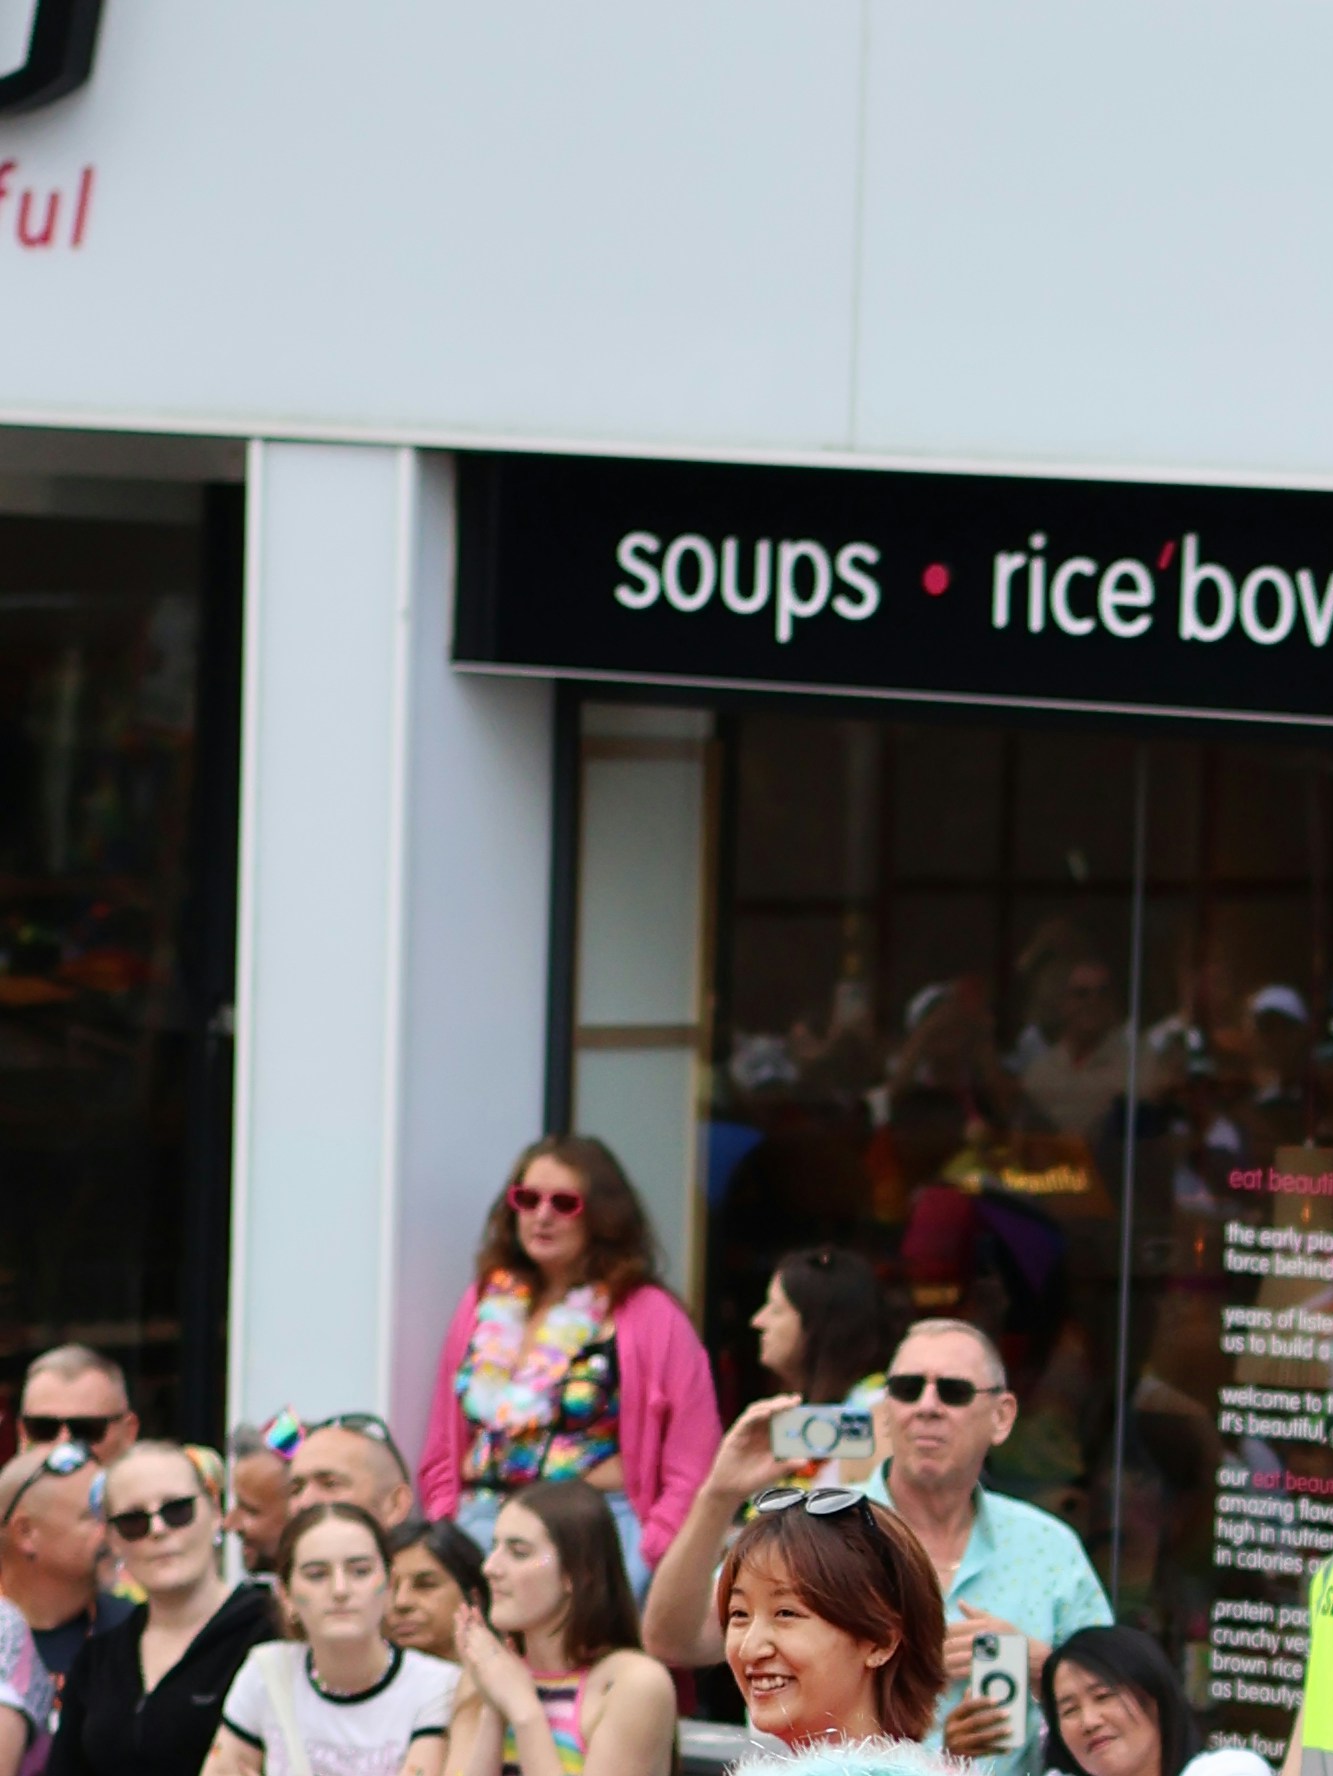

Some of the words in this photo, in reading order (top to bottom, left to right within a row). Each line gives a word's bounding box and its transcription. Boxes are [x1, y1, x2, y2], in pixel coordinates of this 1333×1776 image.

[614, 531, 881, 645] soups
[1227, 1168, 1263, 1190] eat
[1225, 1223, 1254, 1246] the
[1259, 1227, 1302, 1252] early
[1224, 1249, 1270, 1274] force
[1223, 1308, 1272, 1330] years
[1276, 1307, 1296, 1330] of
[1223, 1335, 1245, 1353] us
[1249, 1335, 1267, 1354] to
[1270, 1333, 1314, 1360] build
[1318, 1342, 1331, 1359] a
[1221, 1386, 1301, 1411] welcome
[1304, 1392, 1323, 1413] to
[1217, 1468, 1249, 1487] our
[1252, 1470, 1281, 1490] eat
[1217, 1495, 1295, 1522] amazing
[1216, 1518, 1256, 1544] high
[1259, 1524, 1276, 1543] in
[1215, 1546, 1232, 1566] in
[1236, 1547, 1304, 1574] calories
[1213, 1600, 1275, 1622] protein
[1278, 1606, 1311, 1627] pac
[1212, 1627, 1281, 1653] crunchy
[1211, 1650, 1268, 1675] brown
[1271, 1656, 1304, 1679] rice
[1210, 1680, 1232, 1699] as
[1236, 1679, 1305, 1710] beautys
[1251, 1733, 1286, 1758] four
